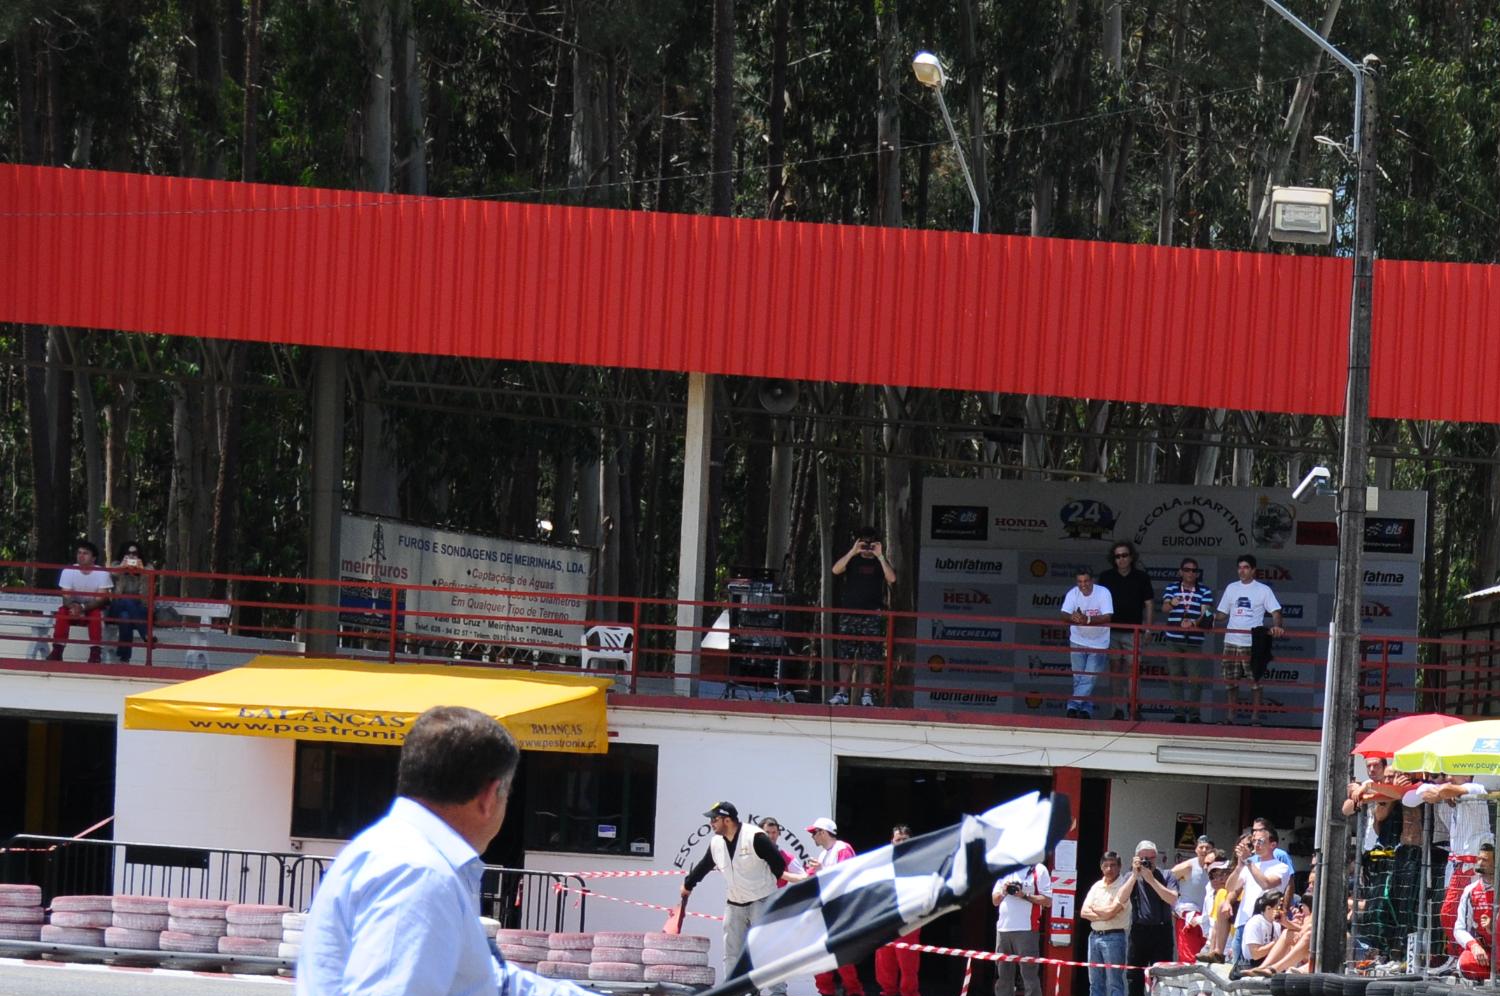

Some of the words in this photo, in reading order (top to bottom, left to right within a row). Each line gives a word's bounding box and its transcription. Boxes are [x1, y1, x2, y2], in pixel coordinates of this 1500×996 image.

[1068, 502, 1101, 522] 24
[995, 517, 1048, 528] HONDA
[1134, 497, 1182, 546] ESCOLA
[1192, 496, 1248, 547] KARTING
[1162, 536, 1224, 547] EUROINDY
[398, 535, 430, 552] FUROS
[432, 542, 438, 553] E
[440, 543, 497, 563] SONDAGENS
[500, 552, 512, 564] DE
[514, 553, 564, 574] MEIRINHAS,
[566, 562, 587, 575] LDA.
[1255, 568, 1293, 580] ELIX
[451, 595, 465, 607] Em
[467, 597, 505, 613] Qualquer
[943, 592, 991, 604] HELIX
[531, 625, 564, 638] POMBAL
[945, 628, 1000, 638] MICHELIN
[531, 723, 583, 737] BALANÇAS
